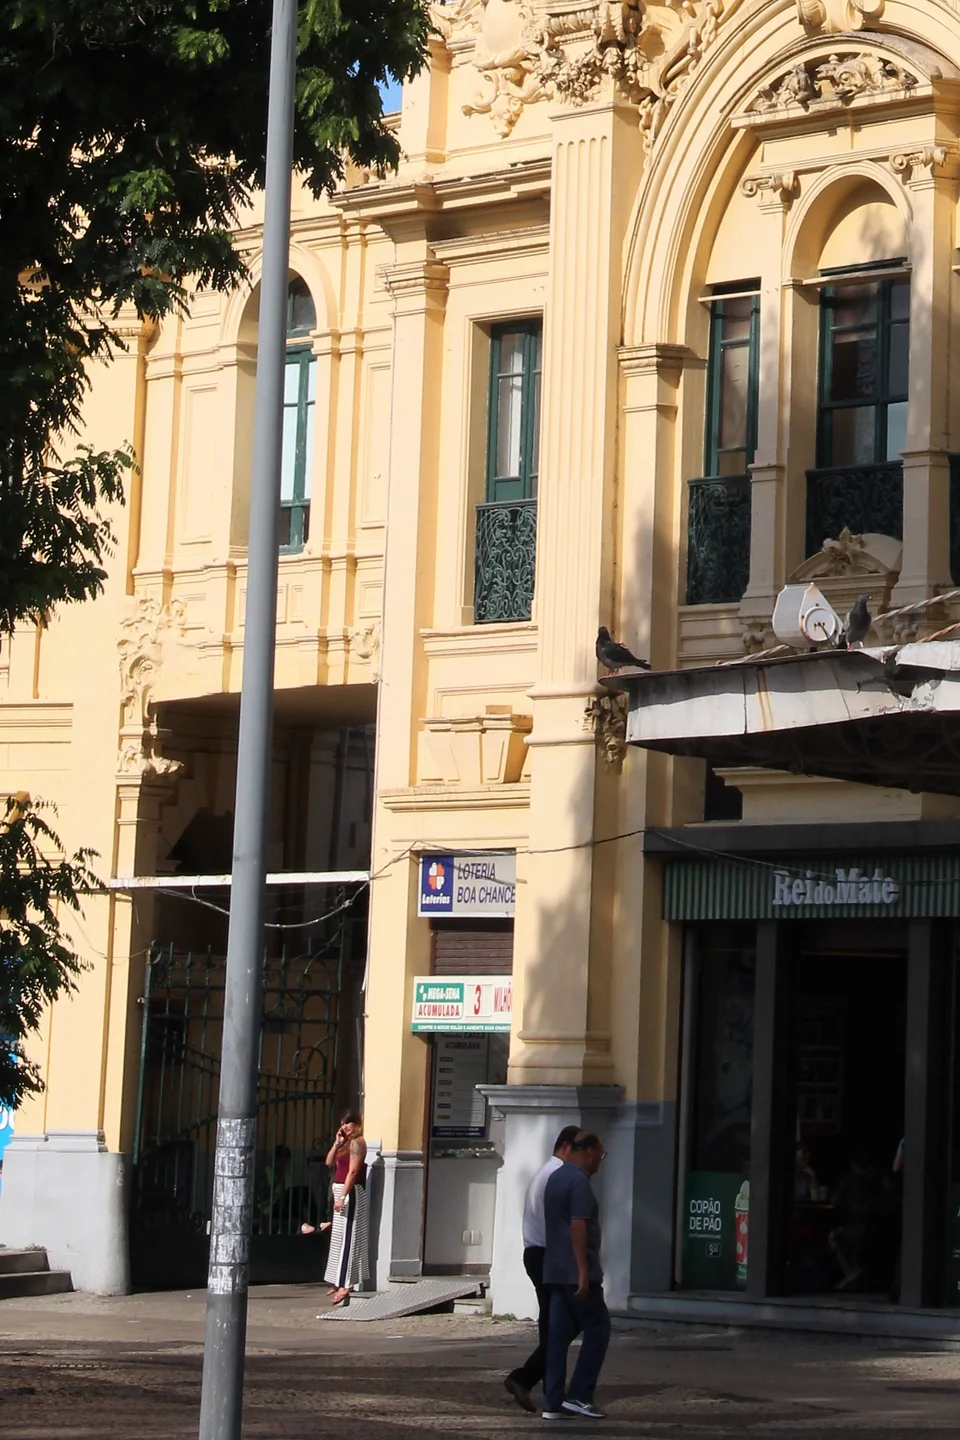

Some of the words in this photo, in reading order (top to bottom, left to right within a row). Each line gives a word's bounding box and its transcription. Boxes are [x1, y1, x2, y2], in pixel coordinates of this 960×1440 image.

[457, 862, 496, 880] LOTERIA
[457, 886, 477, 903] BOA
[478, 886, 516, 903] CHANCE
[773, 869, 812, 905] Rei
[835, 867, 898, 904] Mate
[421, 893, 451, 905] Loterias
[427, 987, 460, 1000] MEGA-SENA
[473, 984, 482, 1015] 3
[418, 1004, 460, 1017] ACUMULADA
[689, 1197, 721, 1214] COPÃO
[689, 1216, 702, 1230] DE
[703, 1214, 722, 1231] PÃO
